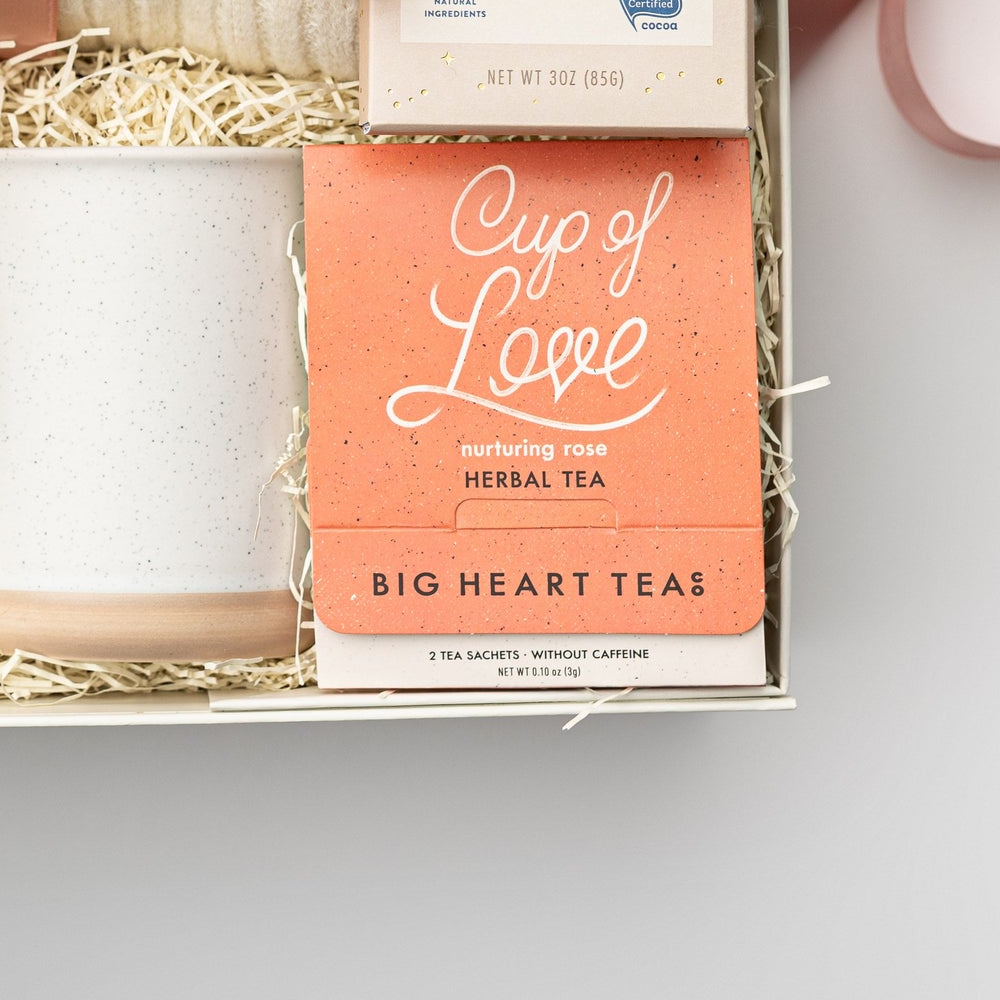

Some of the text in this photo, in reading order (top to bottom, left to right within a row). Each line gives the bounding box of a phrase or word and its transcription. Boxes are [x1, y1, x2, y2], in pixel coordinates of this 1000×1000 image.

[628, 0, 674, 8] Certified
[424, 10, 487, 18] INGREDIENTS
[641, 22, 678, 30] cocoa
[487, 70, 514, 86] NET
[521, 70, 542, 86] WT
[584, 70, 625, 90] (85G)
[450, 164, 674, 300] Cup of
[385, 265, 668, 432] Love
[461, 439, 608, 461] nurturing rose
[465, 471, 606, 489] HERBAL TEA
[373, 572, 440, 597] BIG
[460, 572, 590, 597] HEART
[429, 649, 650, 660] 2 TEA SACHETS WITHOUT CAFFEINE
[498, 666, 581, 678] NET WT 0.10 oz (3g)
